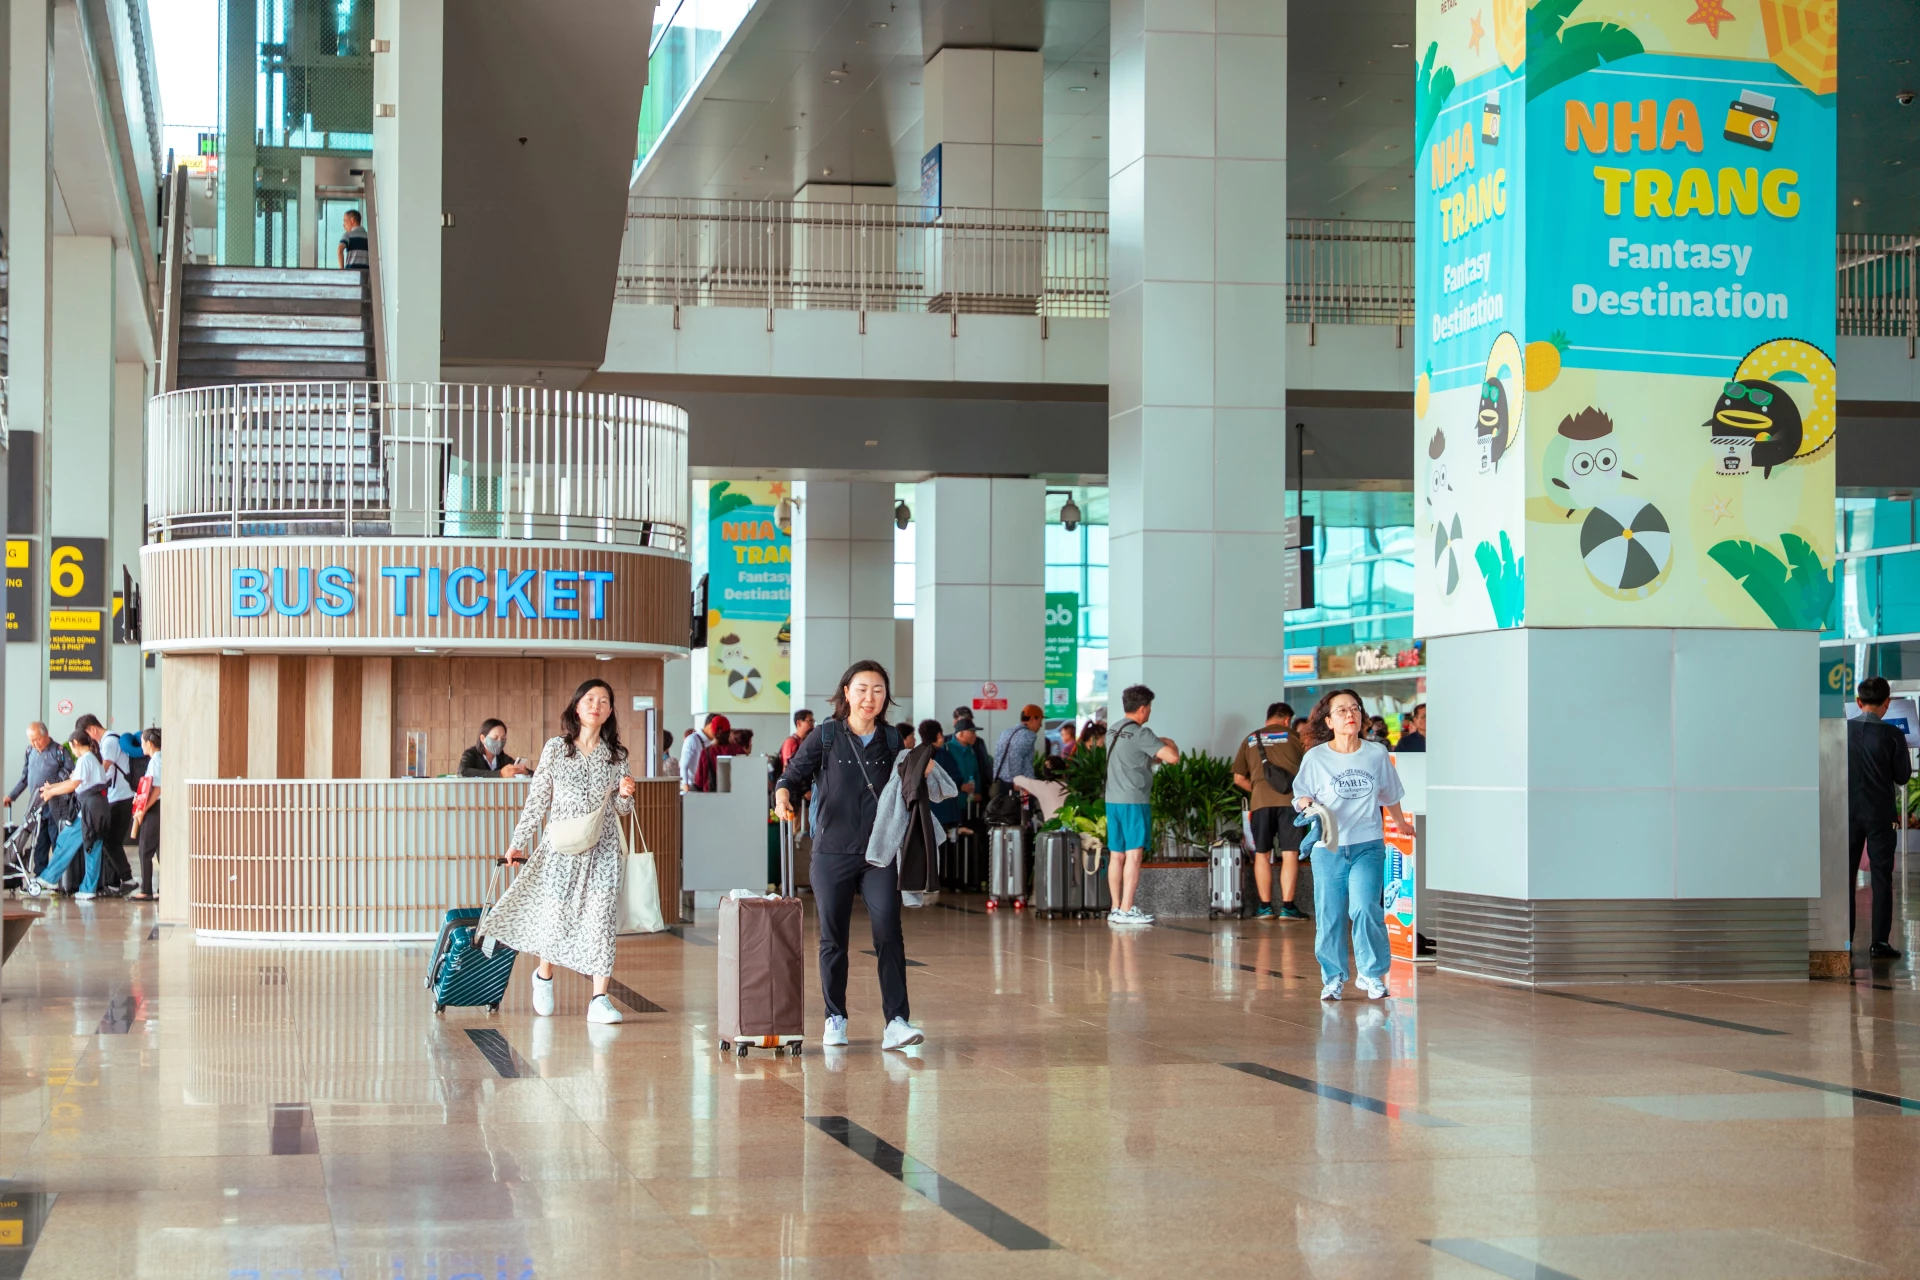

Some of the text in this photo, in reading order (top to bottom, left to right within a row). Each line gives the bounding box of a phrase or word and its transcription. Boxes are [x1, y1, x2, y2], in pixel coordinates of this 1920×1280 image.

[1565, 98, 1704, 153] NHA
[1431, 121, 1475, 191] NHA
[1440, 168, 1506, 243] TRANG
[1593, 165, 1800, 218] TRANG
[1444, 251, 1491, 293] Fantasy
[1608, 237, 1753, 277] Fantasy
[1432, 292, 1503, 343] Destination
[1572, 281, 1789, 319] Destination
[722, 521, 775, 541] NHA
[50, 545, 84, 598] 6
[733, 545, 791, 564] TRAN
[232, 566, 614, 619] BUS TICKET
[724, 587, 791, 601] Destinati
[54, 616, 92, 624] PARKING
[1045, 604, 1073, 626] ab
[1338, 779, 1368, 787] PARIS
